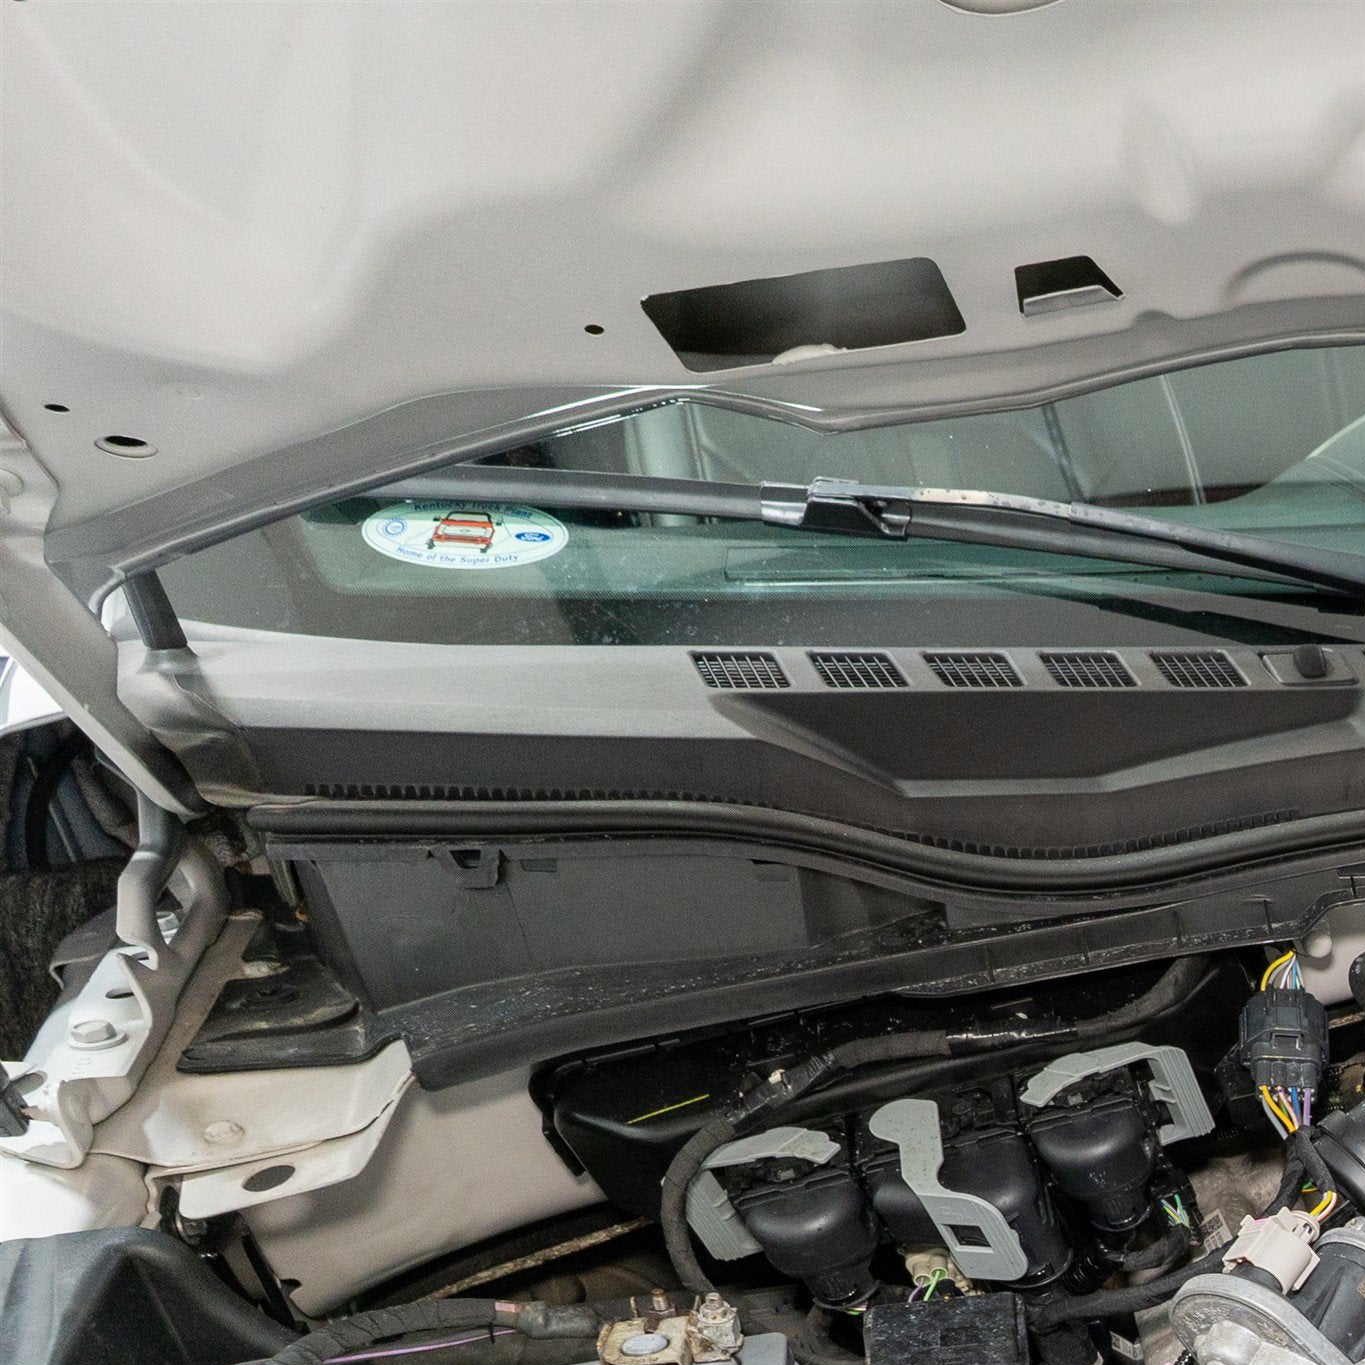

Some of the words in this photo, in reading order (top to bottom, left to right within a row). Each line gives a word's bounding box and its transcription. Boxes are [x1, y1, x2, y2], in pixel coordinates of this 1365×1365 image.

[413, 501, 466, 511] Kentucky
[506, 505, 533, 519] Plant
[396, 547, 422, 559] Home
[440, 555, 456, 563] the
[460, 556, 489, 564] Super
[495, 554, 519, 563] Duty
